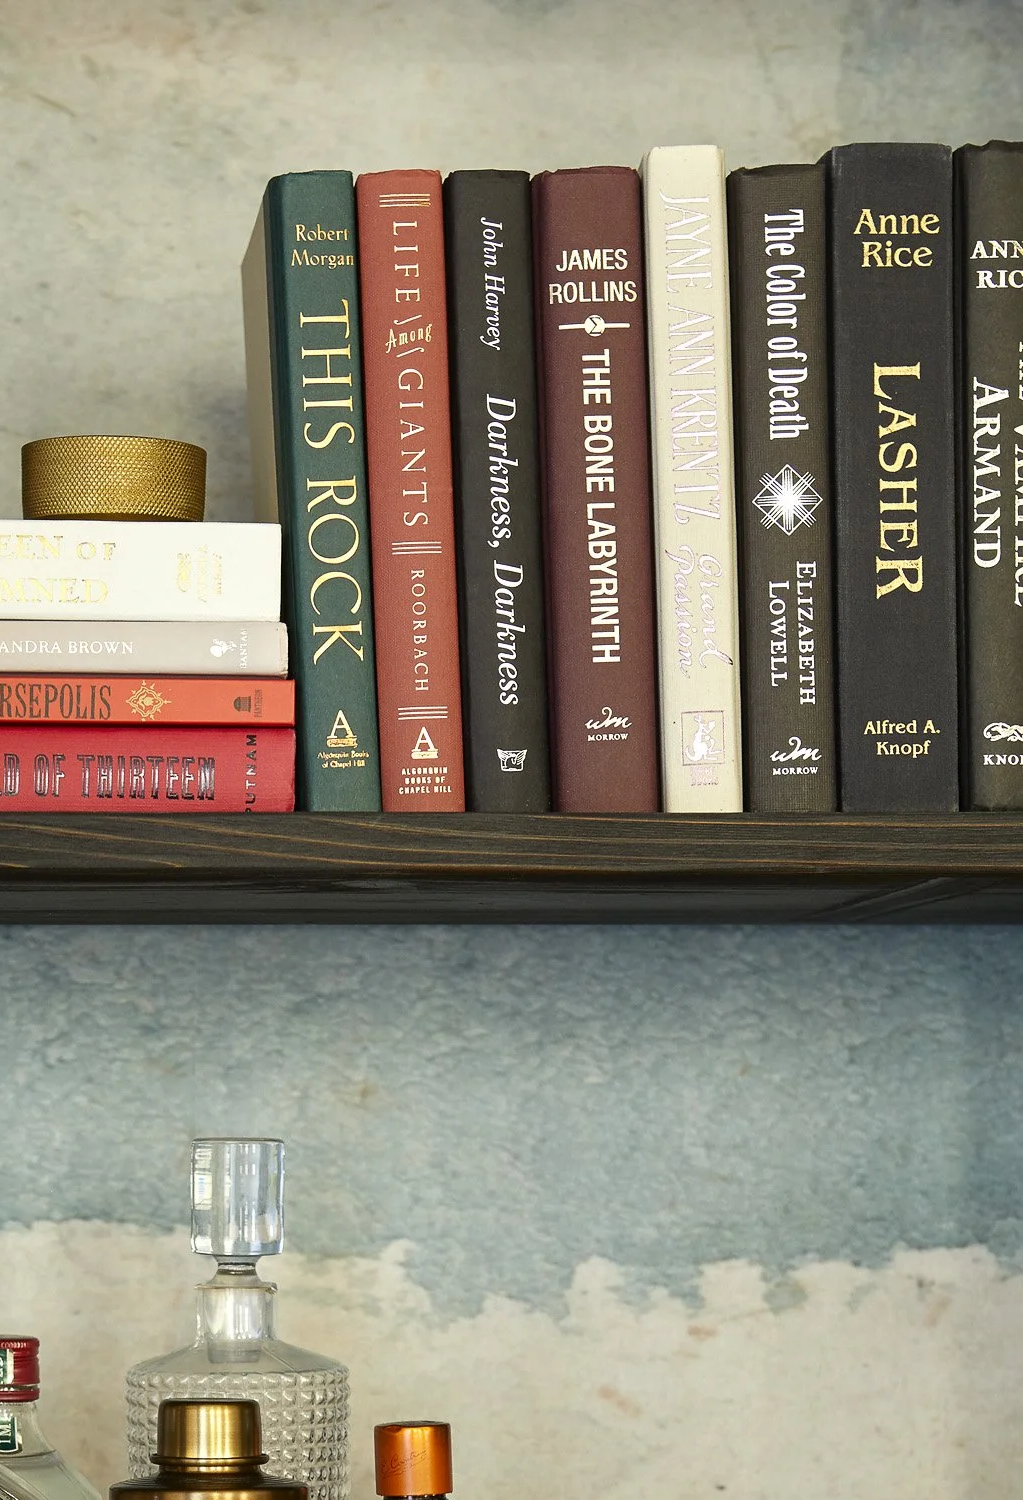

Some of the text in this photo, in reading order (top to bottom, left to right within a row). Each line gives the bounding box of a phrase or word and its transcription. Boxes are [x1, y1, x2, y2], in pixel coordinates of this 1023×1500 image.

[295, 223, 349, 242] Robert
[853, 208, 941, 235] Anne
[290, 249, 354, 269] Morgan
[392, 220, 421, 303] LIFE
[555, 248, 628, 272] JAMES
[861, 240, 933, 268] Rice
[479, 216, 506, 351] John Harvey
[548, 280, 638, 305] ROLLINS
[385, 323, 433, 354] Among
[764, 208, 810, 441] The Color of Death
[659, 188, 721, 525] JAYNE ANN KRENTZ
[398, 368, 429, 527] GIANTS
[299, 298, 364, 666] THIS ROCK
[873, 361, 924, 600] LASHER
[972, 376, 1010, 568] ARMAND
[581, 348, 621, 663] THE BONE LABYRINTH
[77, 541, 116, 561] OF
[486, 393, 526, 705] Darkness, Darkness
[410, 568, 429, 692] ROORBACH
[665, 544, 698, 679] Passion
[698, 553, 734, 669] Grand
[68, 641, 134, 655] BROWN
[239, 629, 248, 669] BANTAM
[768, 580, 790, 687] LOWELL
[796, 560, 818, 705] ELIZABETH
[587, 733, 629, 742] MORROW
[863, 719, 941, 735] Alfred A.
[876, 740, 932, 758] Knopf
[33, 753, 66, 798] OF
[77, 753, 215, 801] THIRTEEN
[398, 785, 452, 795] CHAPEL HILL
[401, 766, 448, 777] ALGONQUIN
[404, 776, 446, 785] BOOKS OF
[772, 766, 819, 776] MORROW
